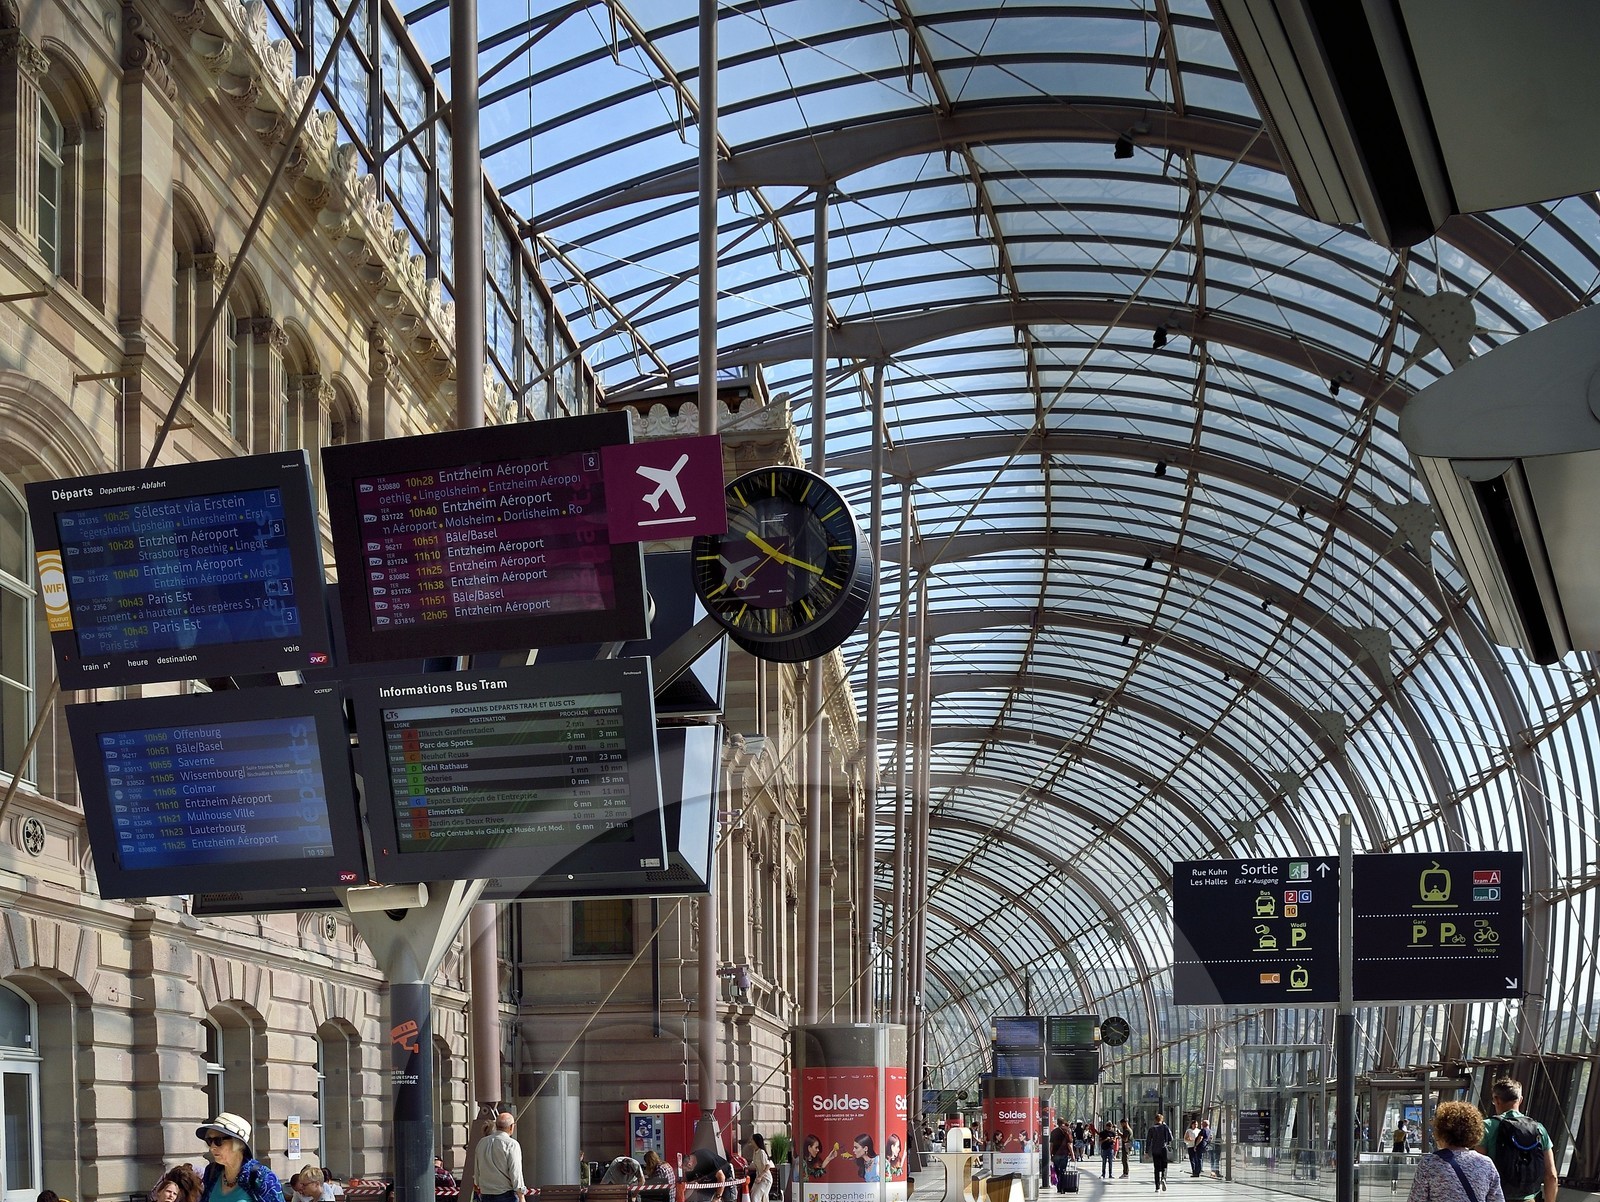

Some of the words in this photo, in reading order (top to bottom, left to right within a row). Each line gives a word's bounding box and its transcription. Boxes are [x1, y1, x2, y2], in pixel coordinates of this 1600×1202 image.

[406, 476, 434, 488] 10h28
[439, 467, 494, 483] Entzheim
[496, 460, 549, 476] Aéroport
[588, 456, 594, 466] 8
[52, 487, 94, 501] Départs
[100, 485, 136, 495] Departures
[141, 480, 166, 490] Abfahrt
[419, 485, 480, 500] Lingolsheim
[488, 478, 538, 492] Entzheim
[104, 510, 130, 522] 10h25
[134, 503, 181, 519] Sélestat
[184, 501, 200, 512] via
[204, 496, 246, 510] Erstein
[409, 506, 438, 518] 10h40
[442, 498, 497, 514] Entzheim
[500, 492, 552, 507] Aéroport
[132, 520, 174, 534] Lipsheim
[182, 512, 238, 526] Limersheim
[392, 520, 438, 533] Aéroport
[446, 514, 495, 528] Molsheim
[504, 506, 560, 522] Dorlisheim
[108, 540, 134, 550] 10h28
[139, 532, 188, 548] Entzheim
[190, 528, 239, 542] Aéroport
[412, 536, 438, 546] 10h51
[446, 528, 498, 543] Bâle/Basel
[139, 547, 189, 562] Strasbourg
[414, 550, 440, 560] 11h10
[448, 544, 496, 557] Entzheim
[498, 538, 544, 552] Aéroport
[113, 568, 139, 580] 10h40
[144, 562, 194, 576] Entzheim
[196, 556, 244, 571] Aéroport
[416, 566, 442, 576] 11h25
[450, 559, 497, 572] Entzheim
[500, 554, 546, 567] Aéroport
[154, 574, 198, 588] Entzheim
[200, 571, 242, 584] Aéroport
[418, 581, 444, 591] 11h38
[451, 574, 498, 587] Entzheim
[502, 569, 548, 582] Aéroport
[44, 583, 65, 594] WIFI
[148, 593, 173, 605] Paris
[176, 592, 192, 602] Est
[420, 596, 446, 606] 11h51
[453, 588, 504, 602] Bâle/Basel
[146, 606, 182, 618] hauteur
[190, 604, 206, 614] des
[208, 600, 243, 612] repères
[422, 610, 448, 620] 12h05
[455, 604, 502, 617] Entzheim
[505, 600, 550, 612] Aéroport
[152, 621, 180, 633] Paris
[183, 618, 202, 630] Est
[100, 641, 122, 650] Paris
[124, 640, 138, 648] Est
[82, 662, 100, 671] train
[128, 658, 148, 668] heure
[156, 654, 198, 665] destination
[284, 644, 300, 653] voie
[380, 684, 452, 698] Informations
[456, 681, 478, 692] Bus
[479, 680, 508, 690] Tram
[450, 706, 488, 714] PROCHAINS
[174, 728, 222, 740] Offenburg
[176, 742, 224, 754] Bâle/Basel
[450, 740, 474, 748] Sports
[178, 756, 215, 768] Saverne
[440, 762, 468, 770] Rathaus
[180, 768, 244, 781] Wissembourg
[182, 785, 216, 794] Colmar
[185, 796, 228, 808] Entzheim
[231, 794, 272, 806] Aéroport
[187, 809, 232, 822] Mulhouse
[234, 808, 255, 818] Ville
[428, 808, 464, 816] Elmerforst
[190, 822, 246, 835] Lauterbourg
[448, 829, 474, 837] Centrale
[192, 837, 235, 848] Entzheim
[238, 834, 279, 847] Aéroport
[1241, 864, 1278, 875] Sortie
[1490, 872, 1500, 883] A
[1488, 888, 1498, 900] D
[1292, 928, 1306, 947] P
[1413, 925, 1428, 944] P
[1440, 922, 1456, 942] P
[1272, 974, 1279, 983] C
[812, 1094, 870, 1110] Soldes
[998, 1110, 1026, 1119] Soldes
[820, 1192, 874, 1200] roppenheim
